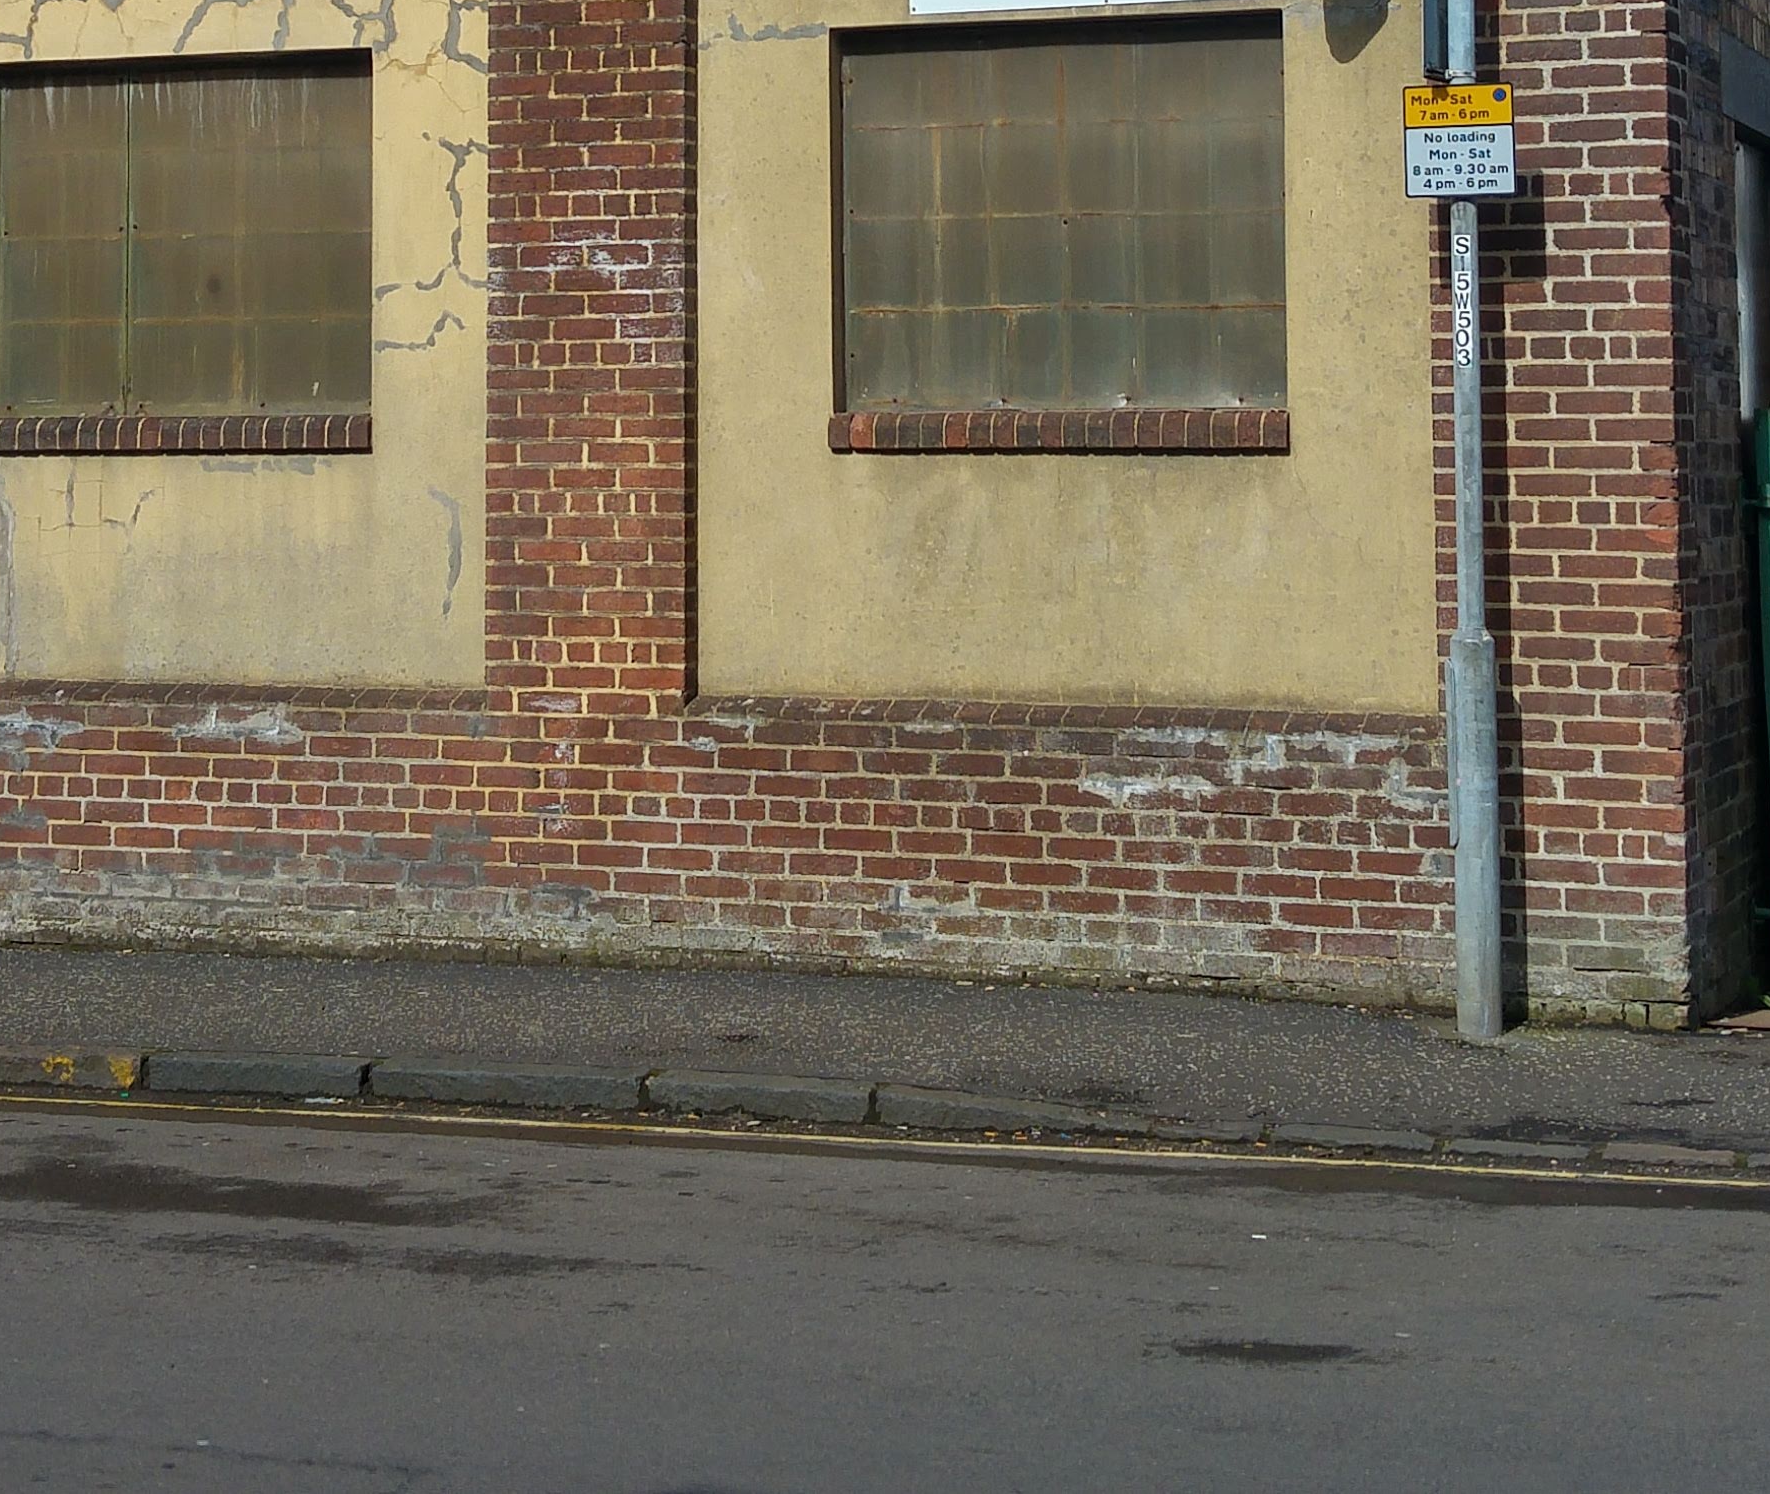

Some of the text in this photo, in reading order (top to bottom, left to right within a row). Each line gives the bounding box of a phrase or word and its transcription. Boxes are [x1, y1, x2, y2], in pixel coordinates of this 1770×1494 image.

[1411, 96, 1438, 106] Mon
[1450, 94, 1473, 104] Sat
[1419, 111, 1427, 120] 7
[1430, 111, 1448, 120] am
[1459, 109, 1467, 119] 6
[1470, 110, 1489, 120] pm
[1424, 131, 1495, 143] No loading
[1429, 149, 1457, 160] Mon
[1469, 148, 1491, 158] Sat
[1413, 165, 1421, 176] 8
[1424, 167, 1443, 175] am
[1454, 164, 1486, 175] 9.30
[1489, 165, 1508, 174] am
[1423, 179, 1432, 189] 4
[1436, 180, 1455, 190] pm
[1466, 178, 1475, 187] 6
[1478, 179, 1498, 189] pm
